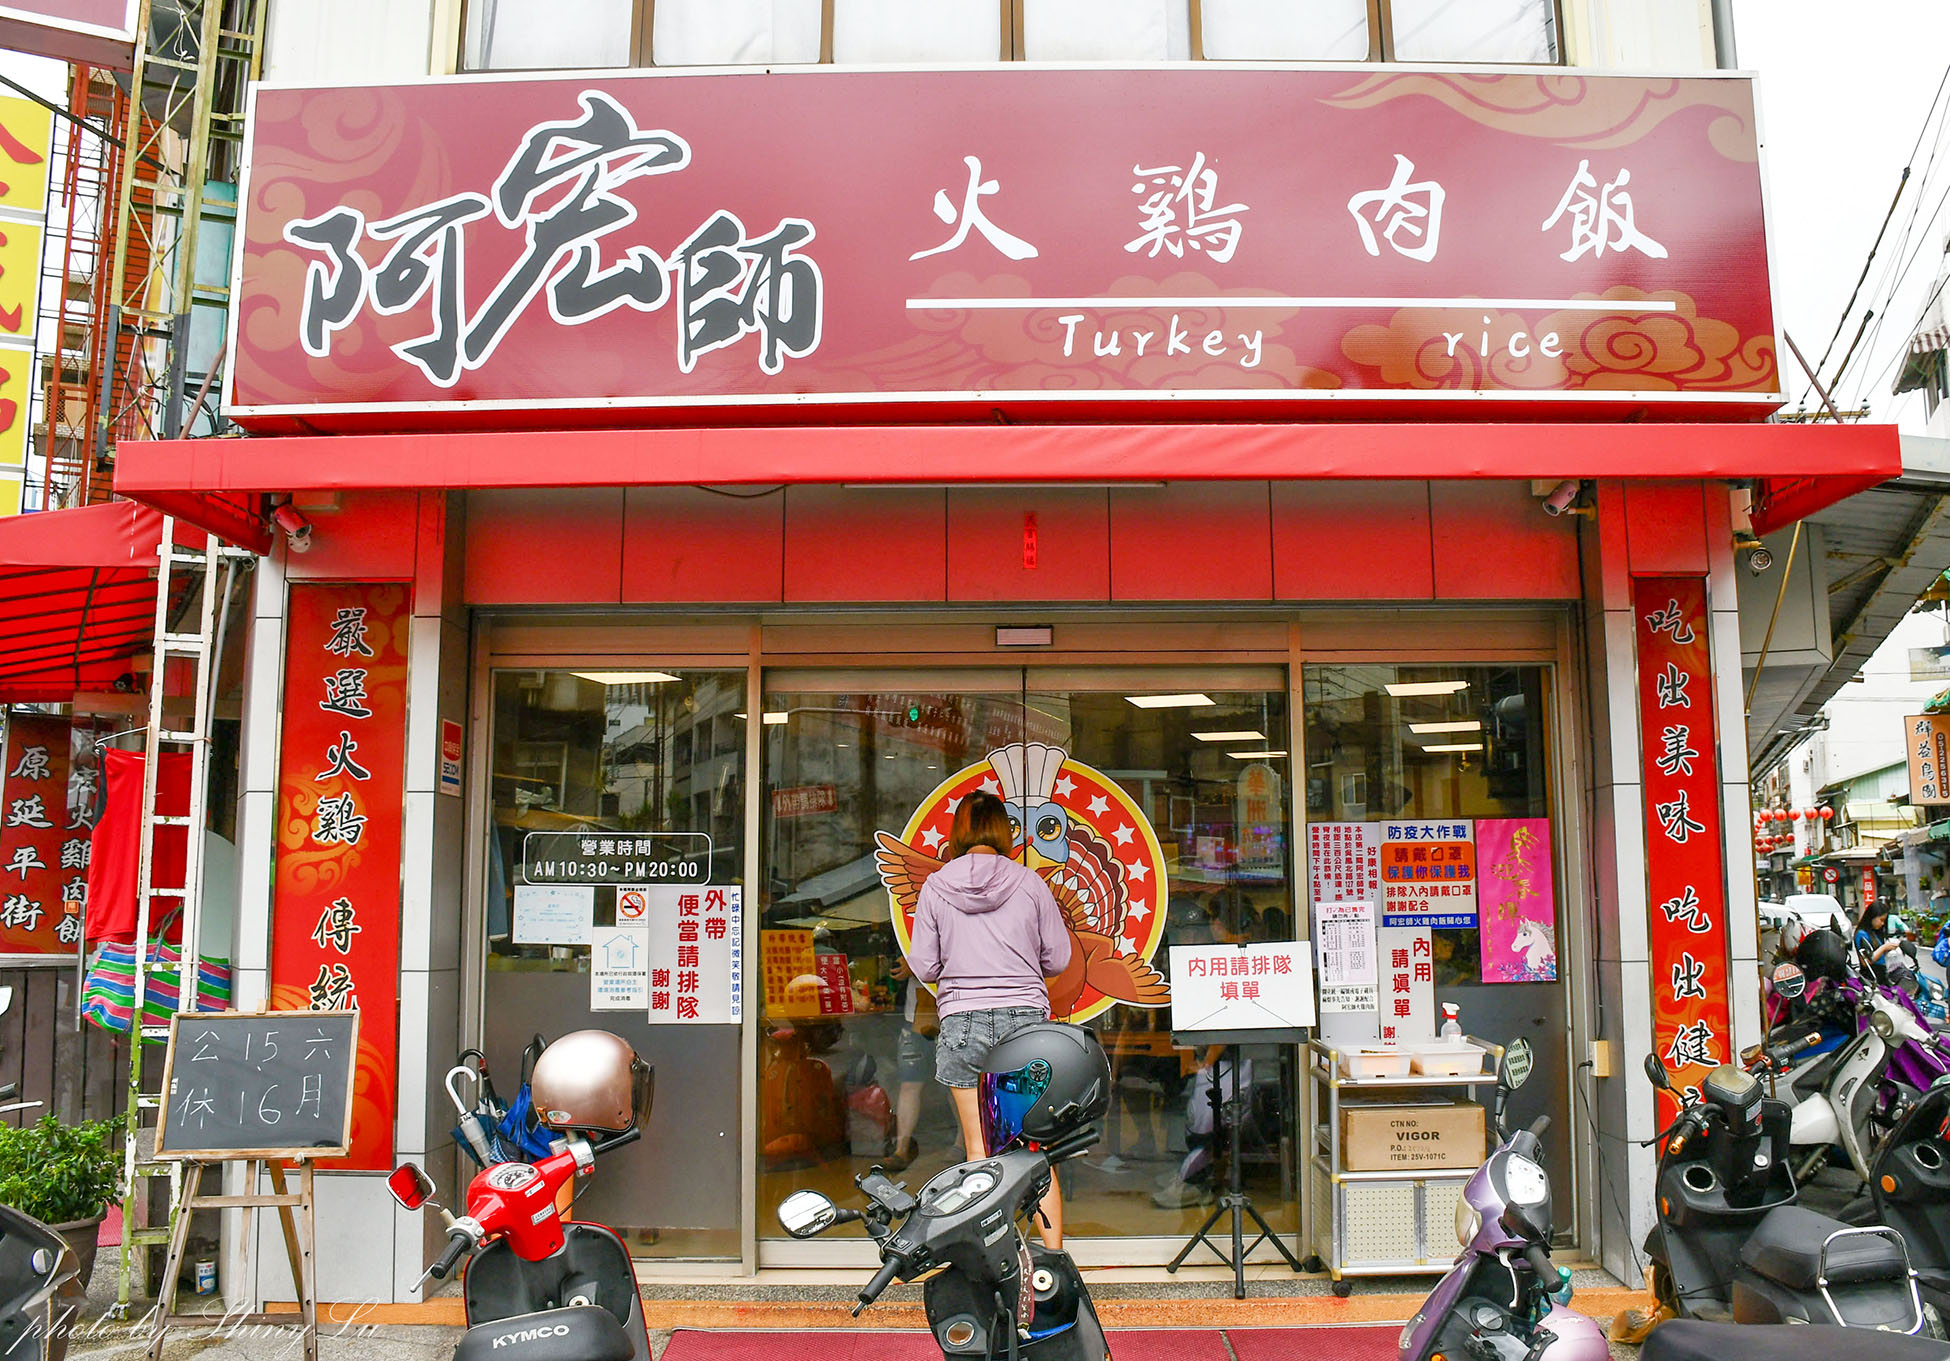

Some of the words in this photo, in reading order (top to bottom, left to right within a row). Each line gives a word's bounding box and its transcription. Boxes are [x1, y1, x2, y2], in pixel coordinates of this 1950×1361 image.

[284, 90, 823, 387] 阿宏師
[1058, 313, 1264, 367] Turkey
[1444, 314, 1564, 358] rice
[1646, 599, 1705, 844] 吃出美味
[1, 746, 53, 932] 原延平街
[1388, 825, 1467, 840] 防疫大作戰
[581, 840, 651, 856] 營業時間
[1395, 846, 1462, 862] 請戴口罩
[704, 889, 727, 940] 外帶
[1387, 900, 1429, 912] 謝謝配合
[677, 894, 699, 1019] 便當請排隊
[652, 968, 670, 1010] 謝謝
[1220, 980, 1261, 1000] 填單
[1383, 1026, 1396, 1046] 謝
[1396, 1131, 1440, 1141] VIGOR
[492, 1324, 570, 1349] KYMCO
